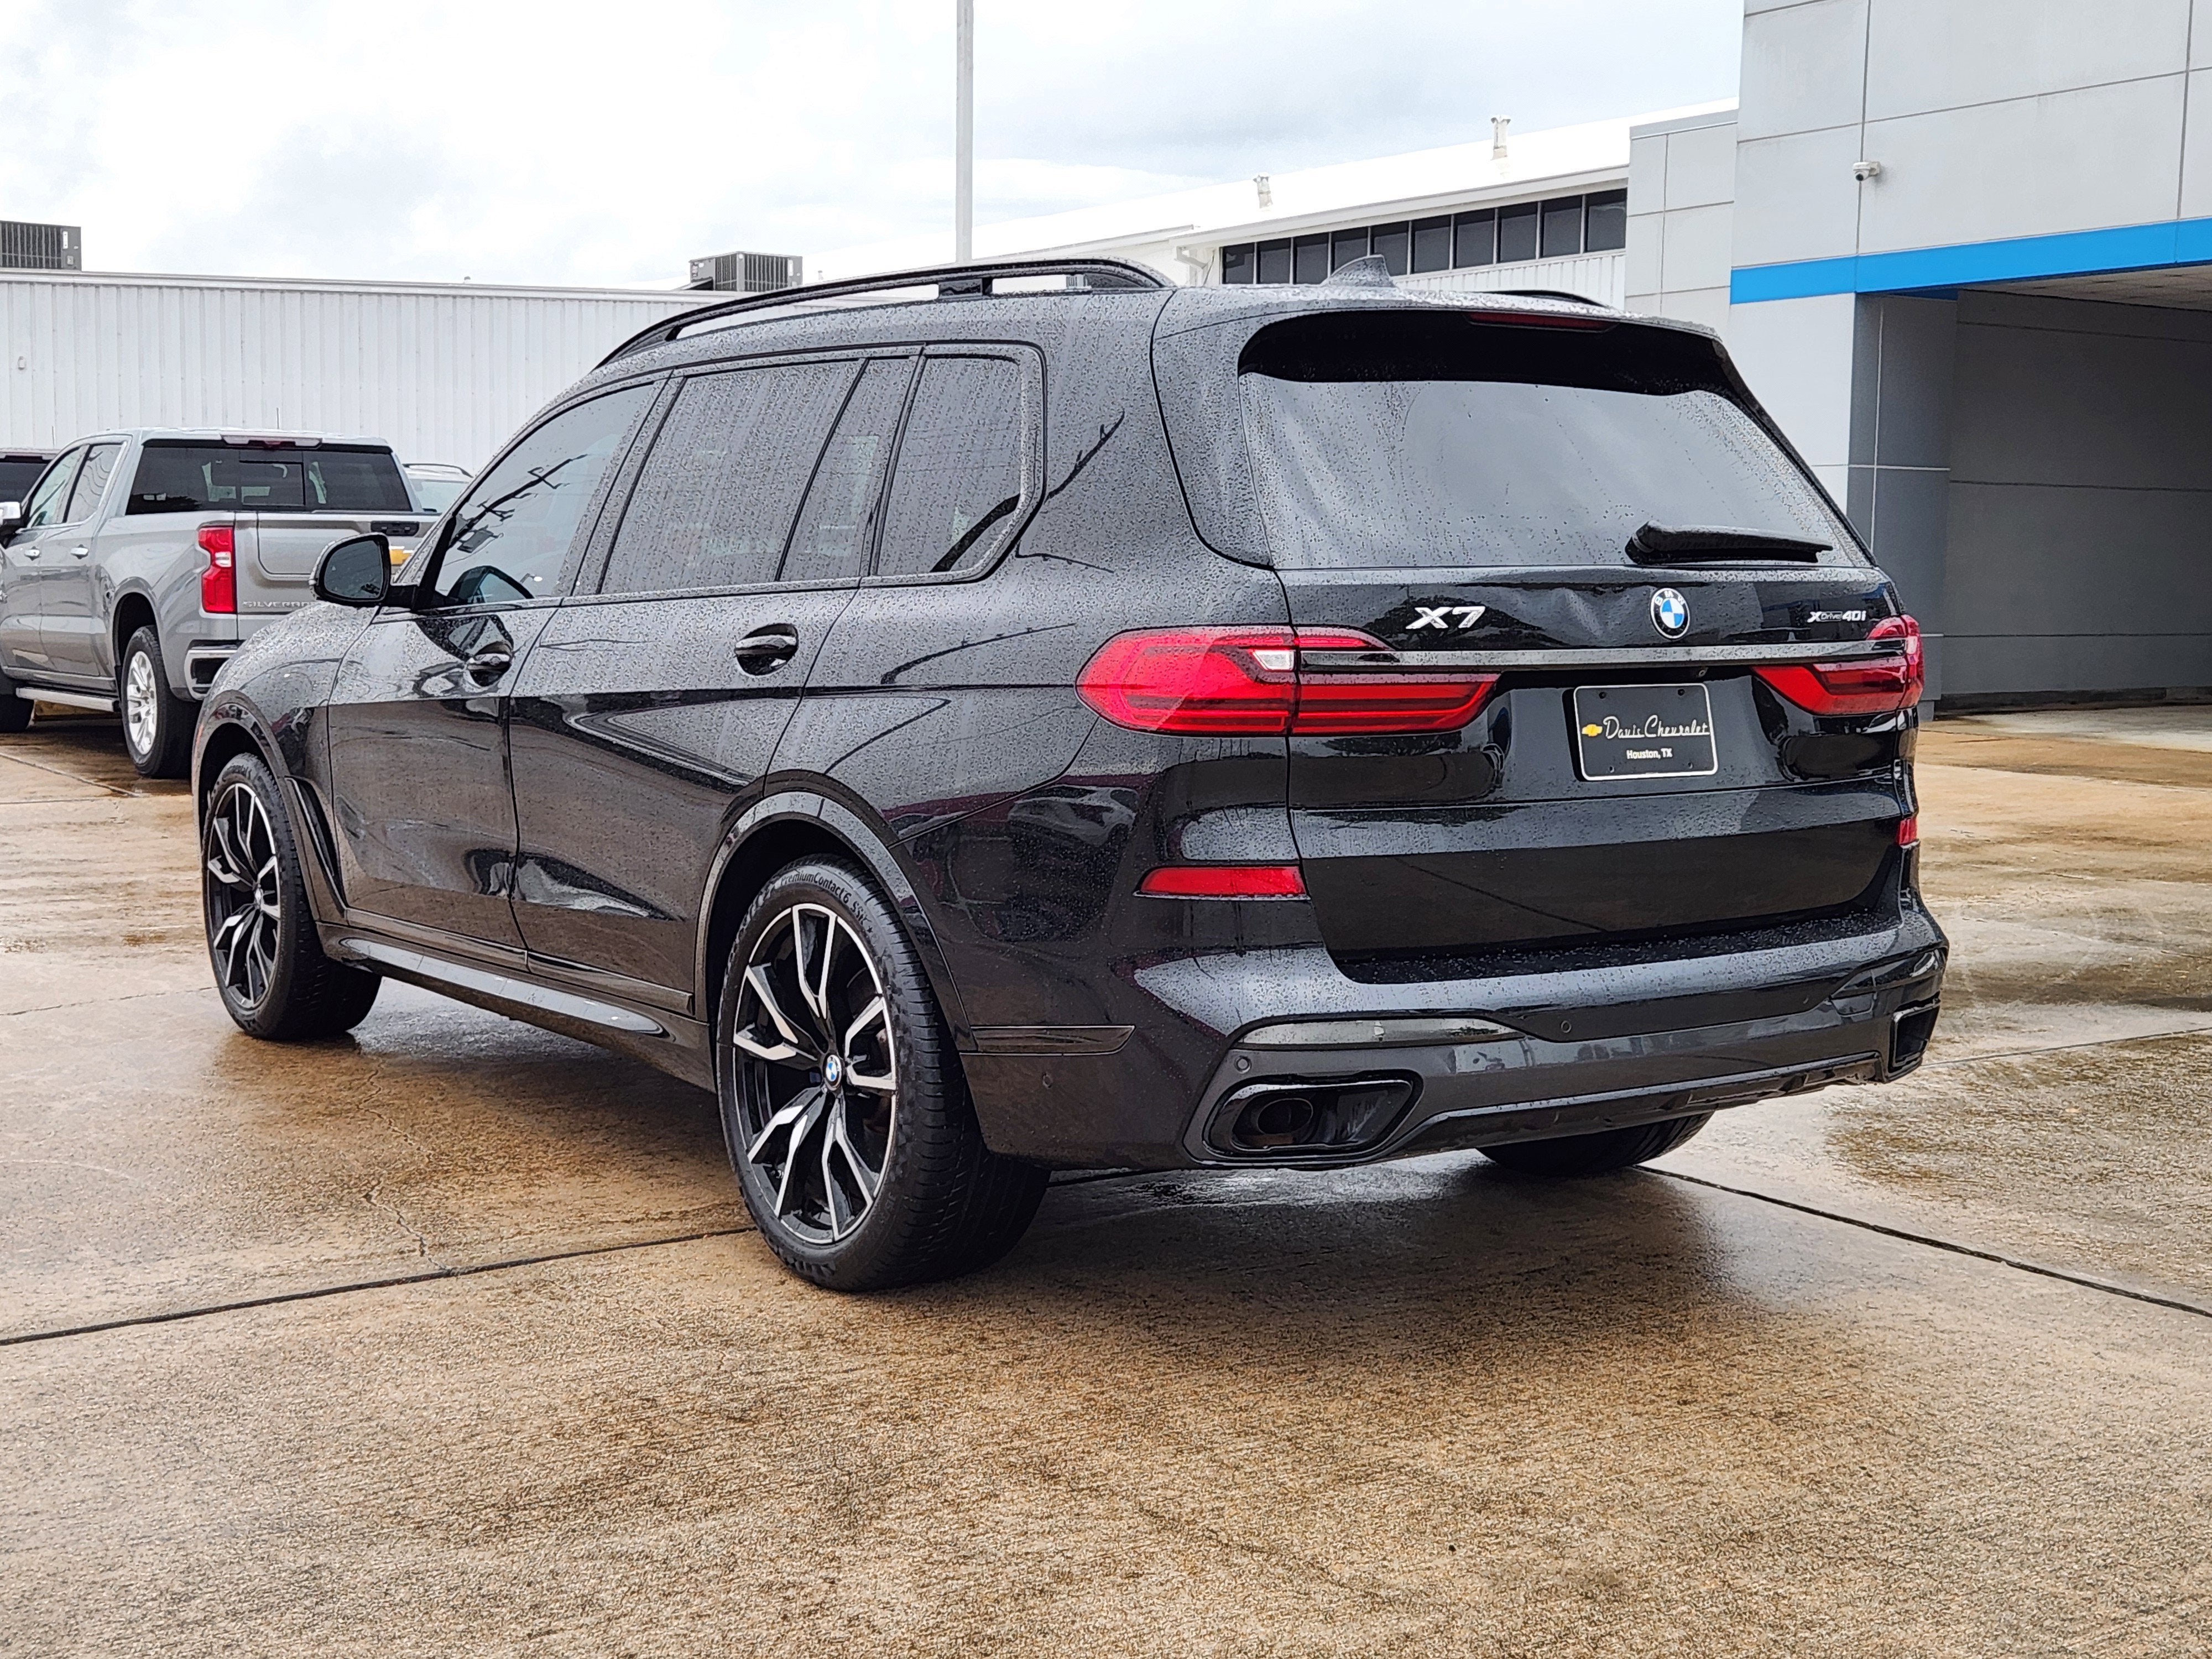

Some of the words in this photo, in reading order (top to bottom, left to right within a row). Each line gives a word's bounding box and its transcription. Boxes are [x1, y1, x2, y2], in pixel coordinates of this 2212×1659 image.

[1405, 606, 1486, 629] X7
[1644, 714, 1710, 738] Chevrolet
[1626, 749, 1661, 760] Houston,
[1660, 748, 1673, 758] TX
